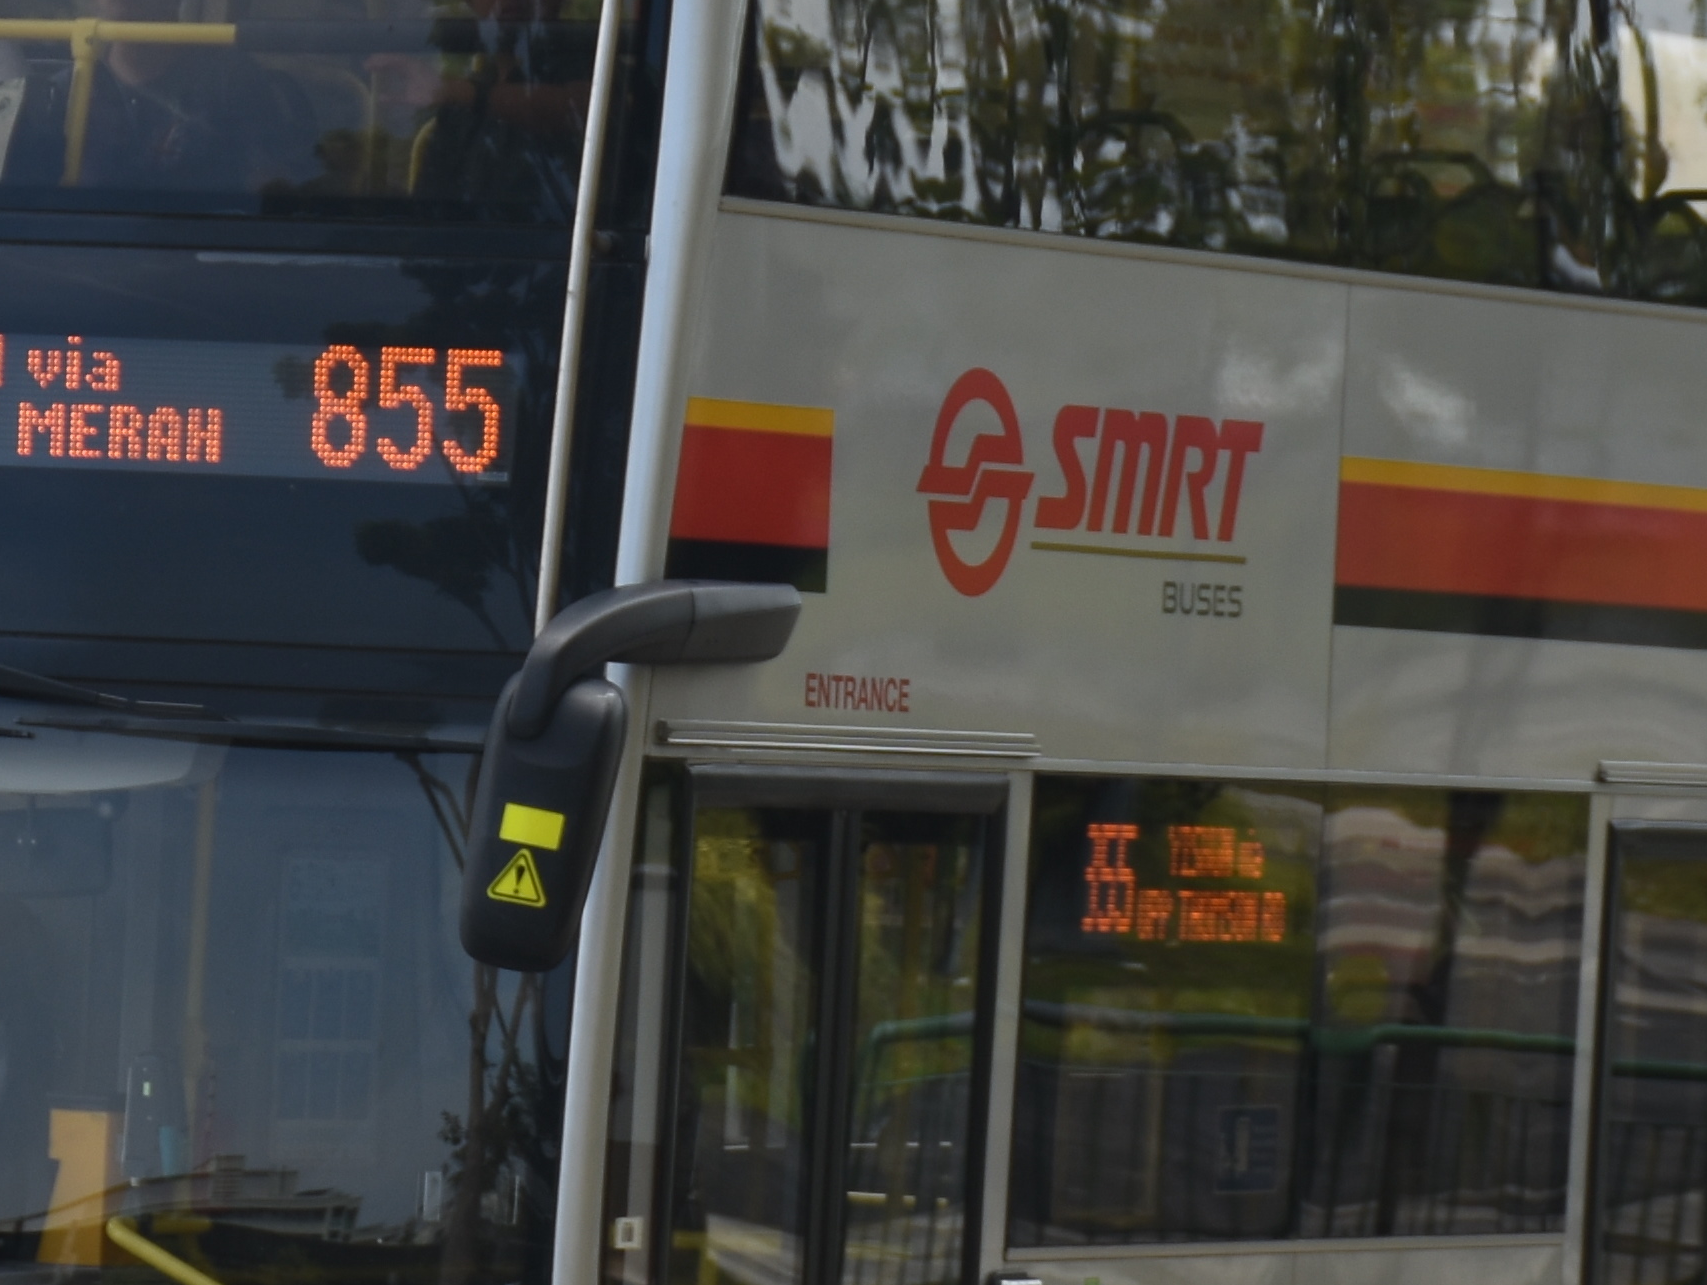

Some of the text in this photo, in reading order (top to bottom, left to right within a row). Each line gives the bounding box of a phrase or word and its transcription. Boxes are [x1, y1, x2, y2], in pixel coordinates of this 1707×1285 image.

[27, 334, 122, 392] via
[16, 402, 222, 464] MERAH
[309, 343, 504, 473] 855
[1034, 403, 1264, 542] SMRT
[1161, 580, 1244, 619] BUSES
[804, 672, 911, 713] ENTRANCE
